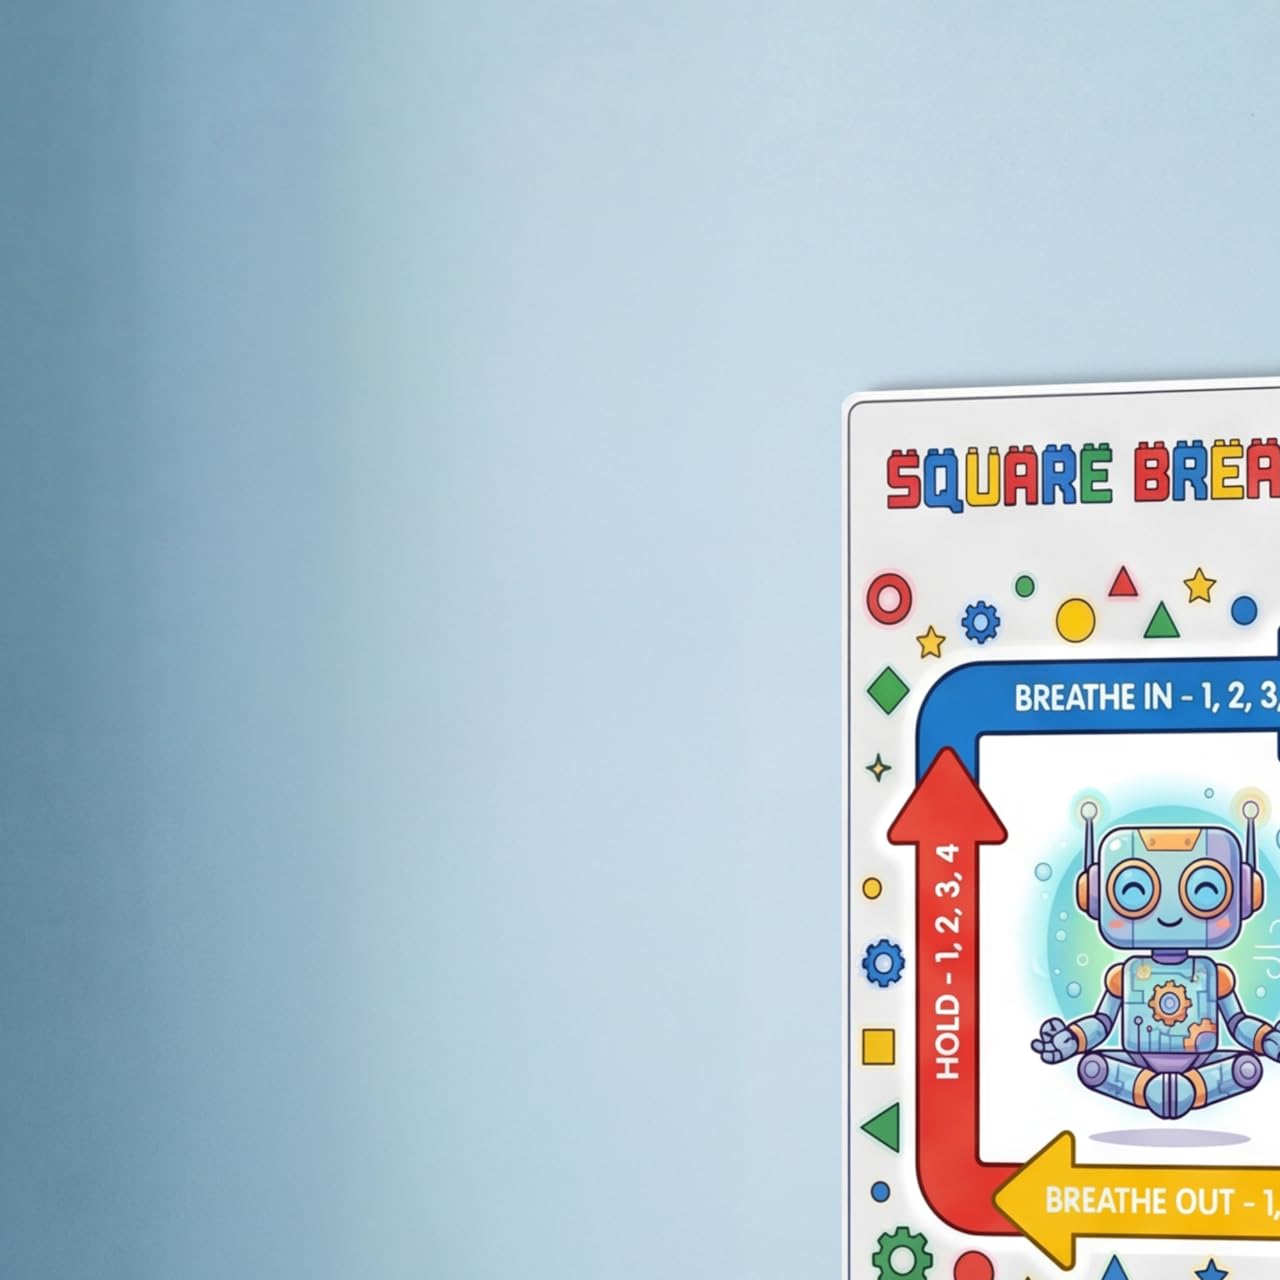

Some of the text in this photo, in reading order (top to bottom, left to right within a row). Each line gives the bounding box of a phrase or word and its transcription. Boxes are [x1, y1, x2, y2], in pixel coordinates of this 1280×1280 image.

[887, 443, 1113, 513] SQUARE
[1015, 683, 1135, 712] BREATHE
[1144, 682, 1173, 710] IN
[1201, 682, 1220, 713] 1,
[1228, 681, 1252, 713] 2,
[936, 843, 960, 863] 4
[935, 872, 963, 897] 3,
[935, 908, 963, 933] 2,
[935, 943, 963, 962] 1,
[935, 994, 960, 1079] HOLD
[1046, 1186, 1167, 1214] BREATHE
[1176, 1188, 1235, 1215] OUT
[1264, 1190, 1280, 1220] 1,
